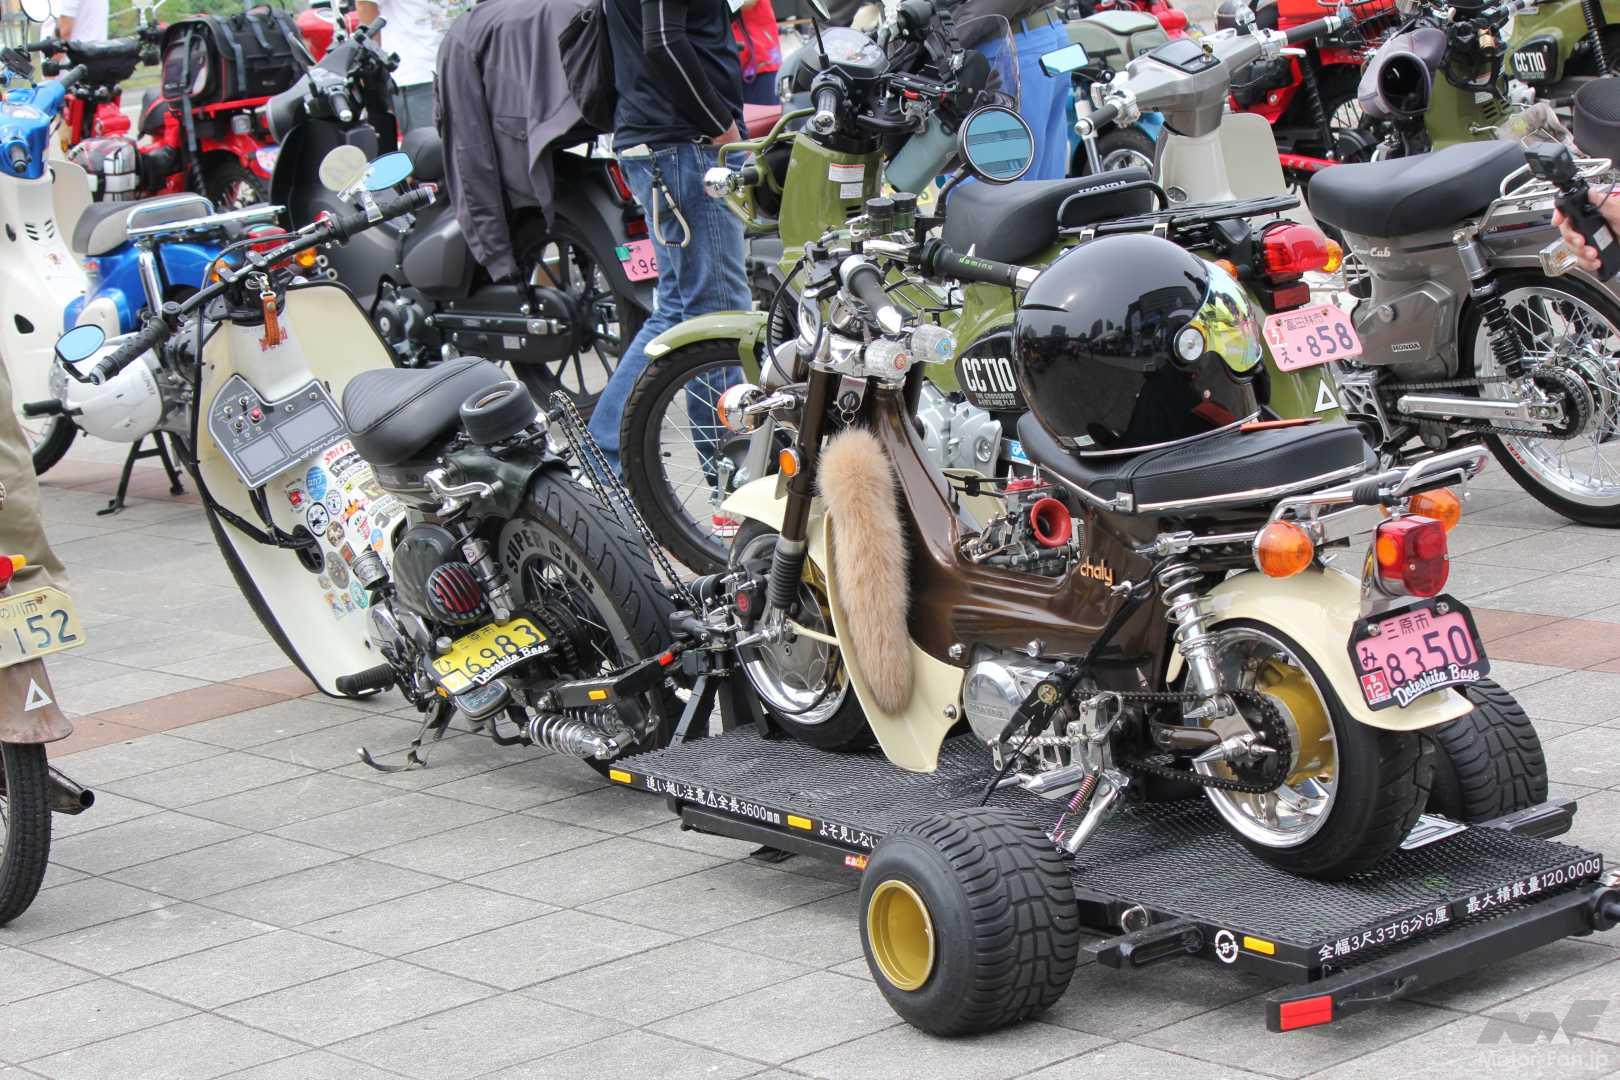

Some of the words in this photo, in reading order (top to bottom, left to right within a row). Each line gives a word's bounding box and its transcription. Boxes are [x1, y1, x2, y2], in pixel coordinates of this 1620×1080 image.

[1514, 52, 1547, 72] CC110
[1370, 247, 1391, 257] Cub
[1392, 342, 1421, 352] HONDA
[962, 358, 1017, 392] CC110
[507, 529, 545, 574] SUPER
[549, 541, 595, 594] CUB
[1080, 556, 1113, 586] chaly
[1384, 613, 1429, 640] 三原市
[466, 625, 540, 674] 6983
[520, 644, 550, 659] Base
[1362, 647, 1378, 667] み
[1386, 625, 1472, 684] 8350
[1449, 664, 1480, 681] Base
[1367, 682, 1386, 699] 12
[646, 776, 706, 803] 追い越し注意
[718, 794, 780, 825] 全長3600mm
[1319, 905, 1449, 961] 全幅3尺3寸6分6厘
[1465, 858, 1600, 914] 最大積載量120,000g
